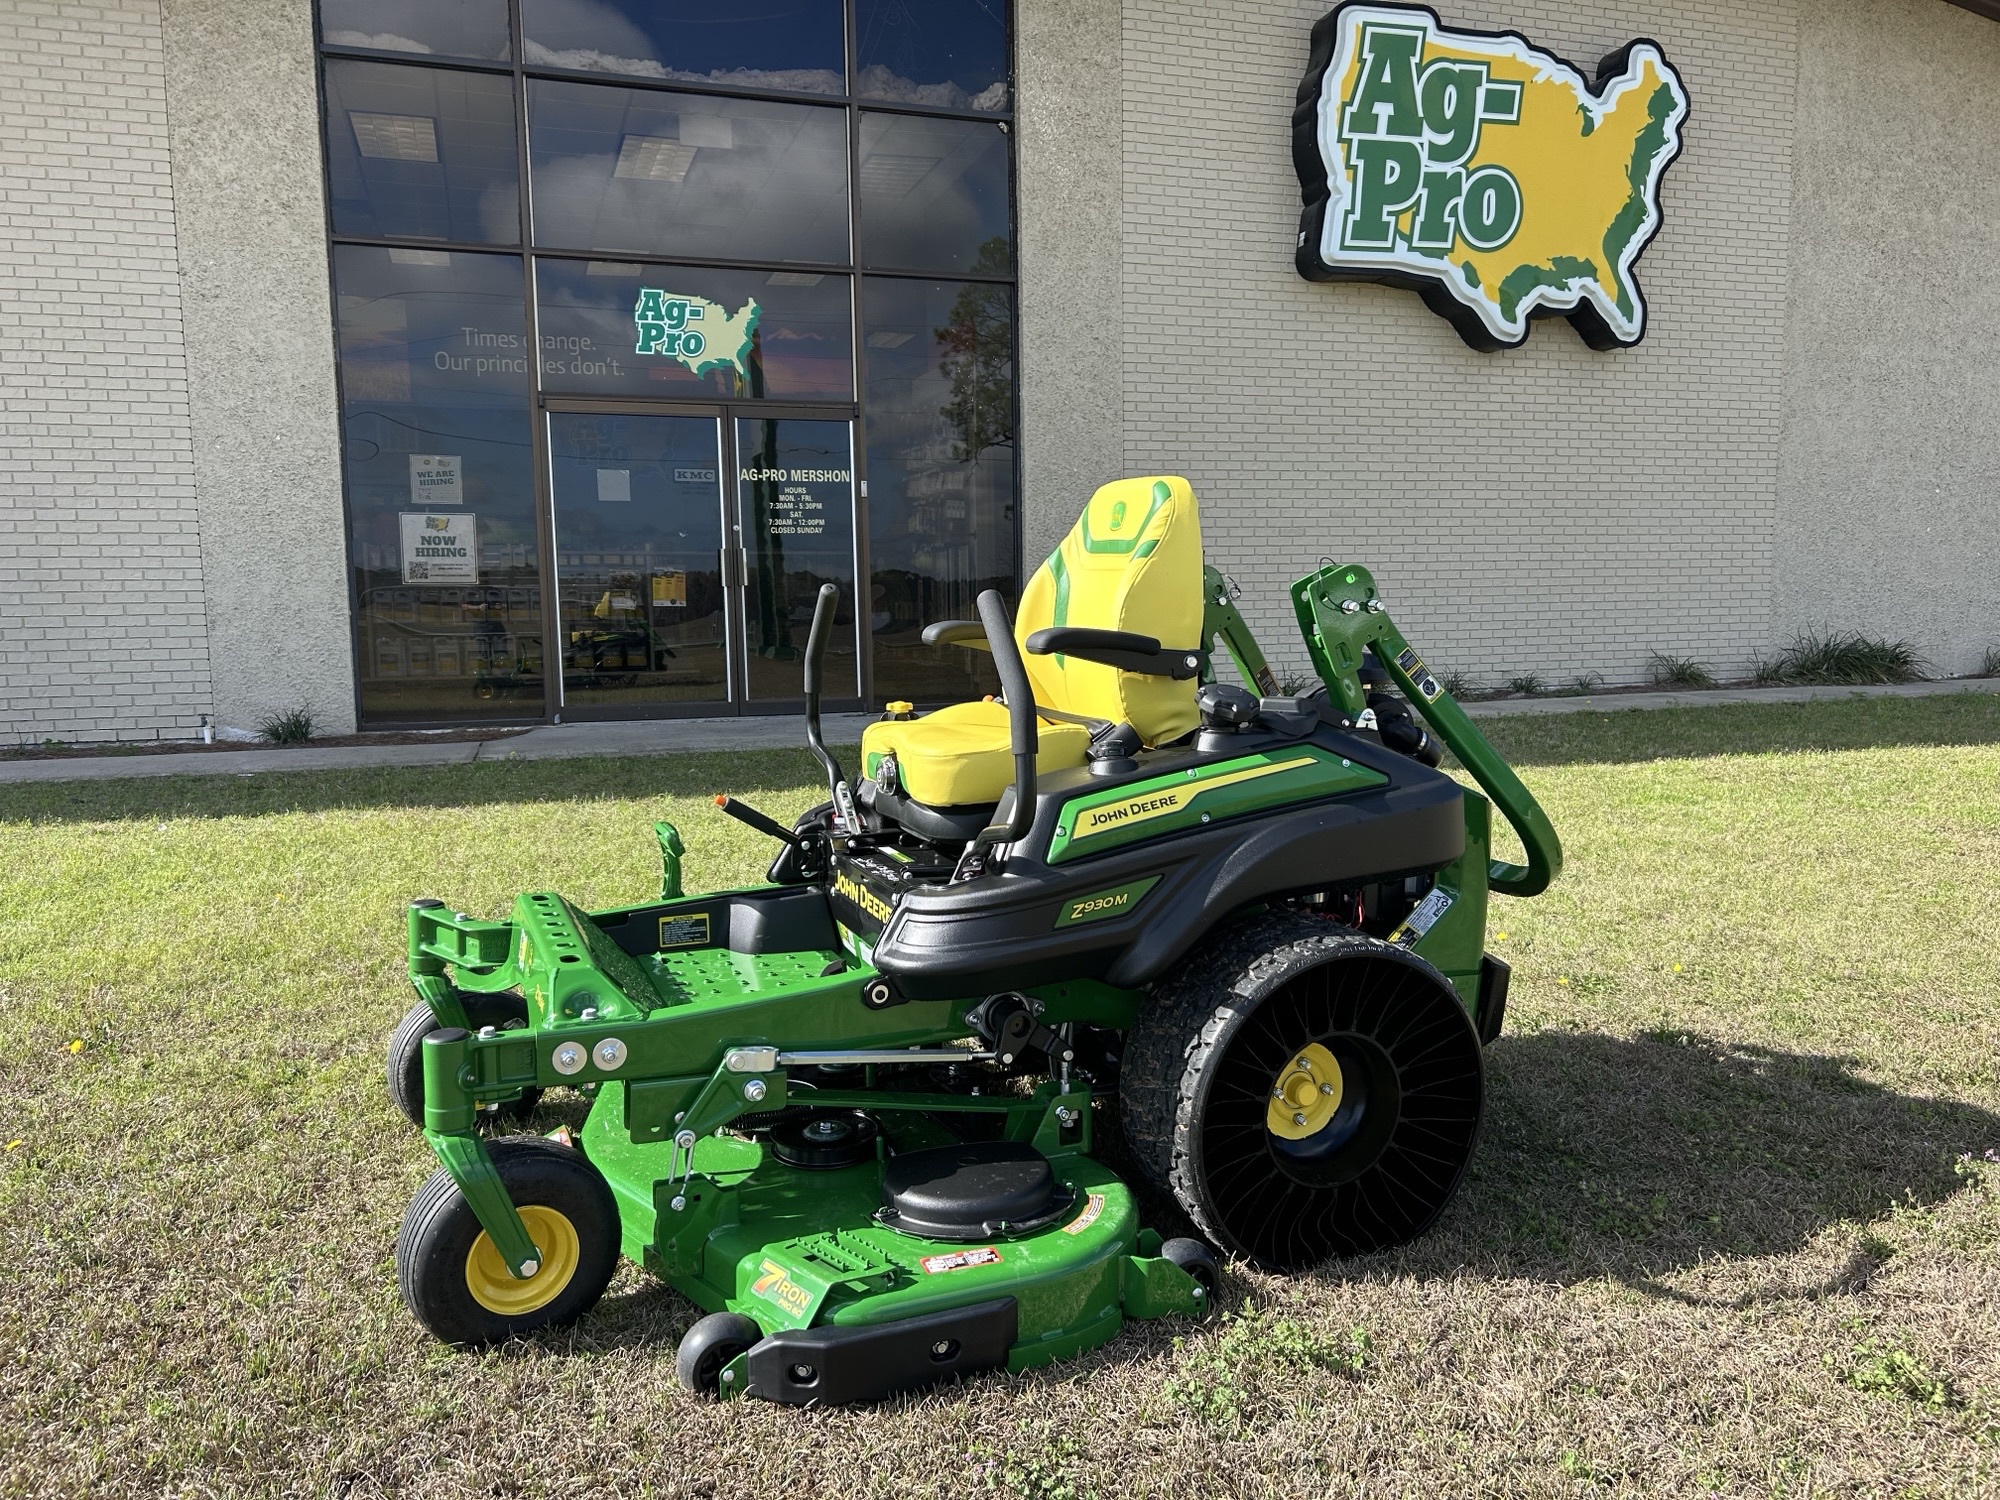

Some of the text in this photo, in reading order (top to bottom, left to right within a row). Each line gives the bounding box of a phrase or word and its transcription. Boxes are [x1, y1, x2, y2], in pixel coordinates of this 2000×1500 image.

[1342, 22, 1522, 166] Ag-
[1342, 139, 1522, 251] Pro
[635, 289, 704, 331] Ag-
[461, 327, 518, 348] Times
[635, 321, 705, 357] Pro
[434, 351, 471, 370] Our
[476, 354, 566, 376] princiles
[419, 478, 454, 486] HIRING
[435, 470, 455, 478] ARE
[676, 470, 714, 480] KMC
[740, 468, 850, 482] AG-PRO MERSHON
[415, 547, 467, 558] HIRING
[420, 535, 457, 546] NOW
[1090, 795, 1178, 826] JOHN DEERE
[834, 869, 859, 904] JOHN
[1070, 893, 1128, 920] Z930M
[753, 1260, 811, 1309] 7 IRON
